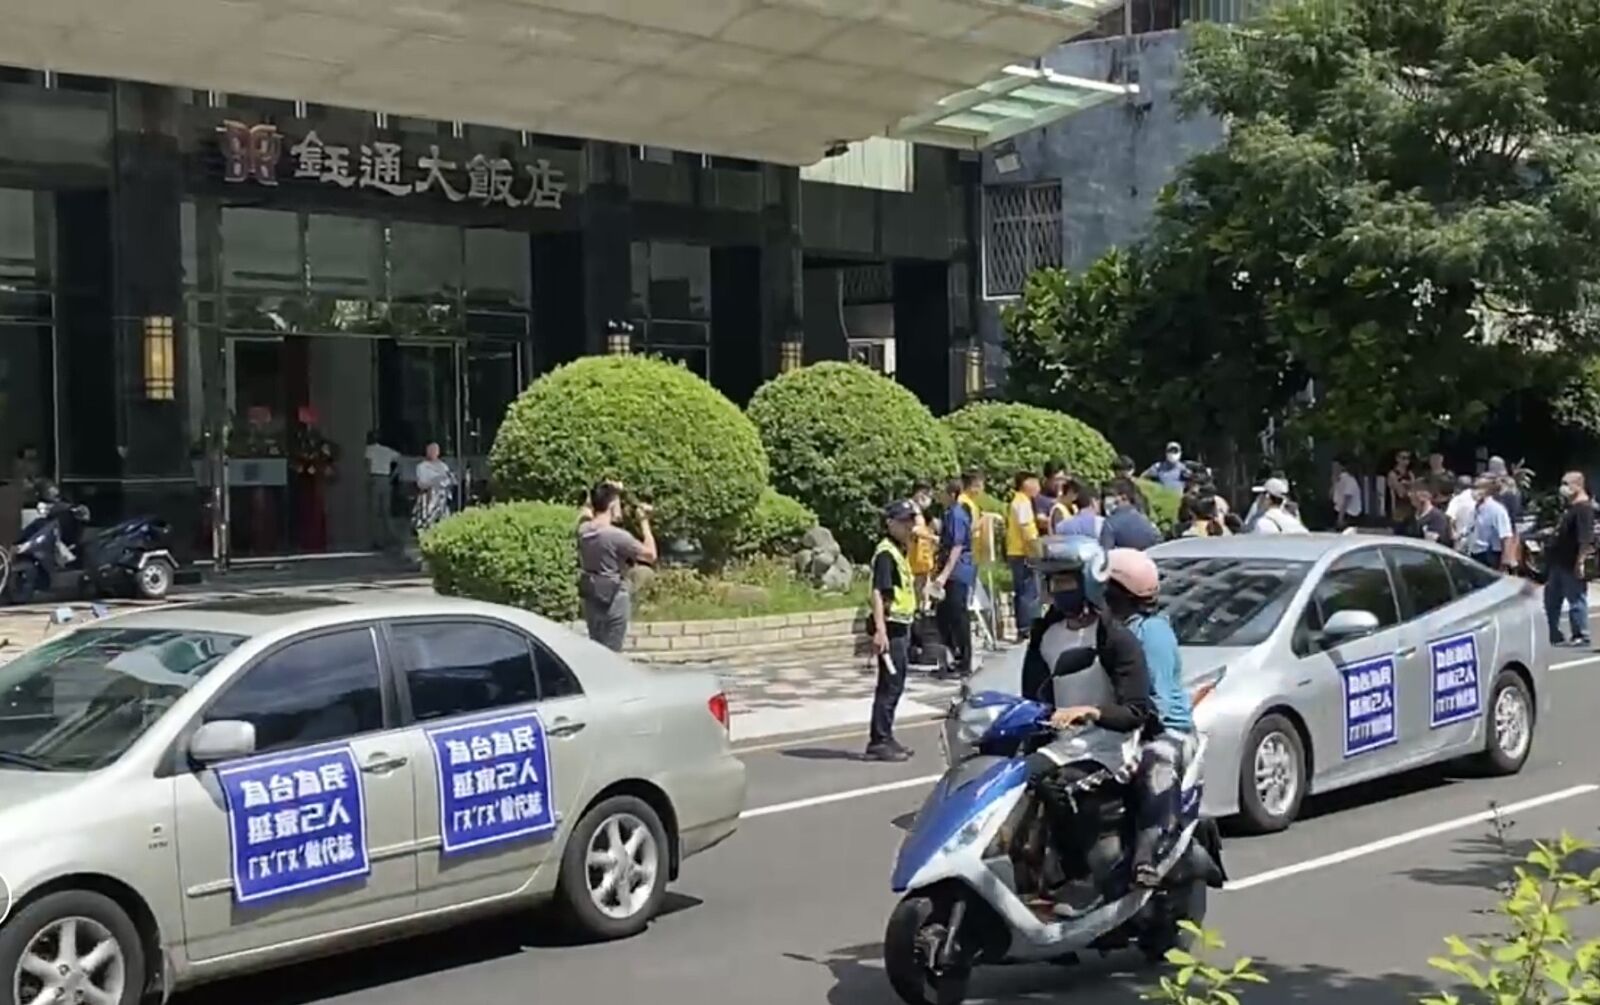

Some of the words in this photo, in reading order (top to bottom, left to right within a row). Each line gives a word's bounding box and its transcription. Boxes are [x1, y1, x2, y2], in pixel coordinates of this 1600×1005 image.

[290, 130, 568, 209] 鈺通大飯店
